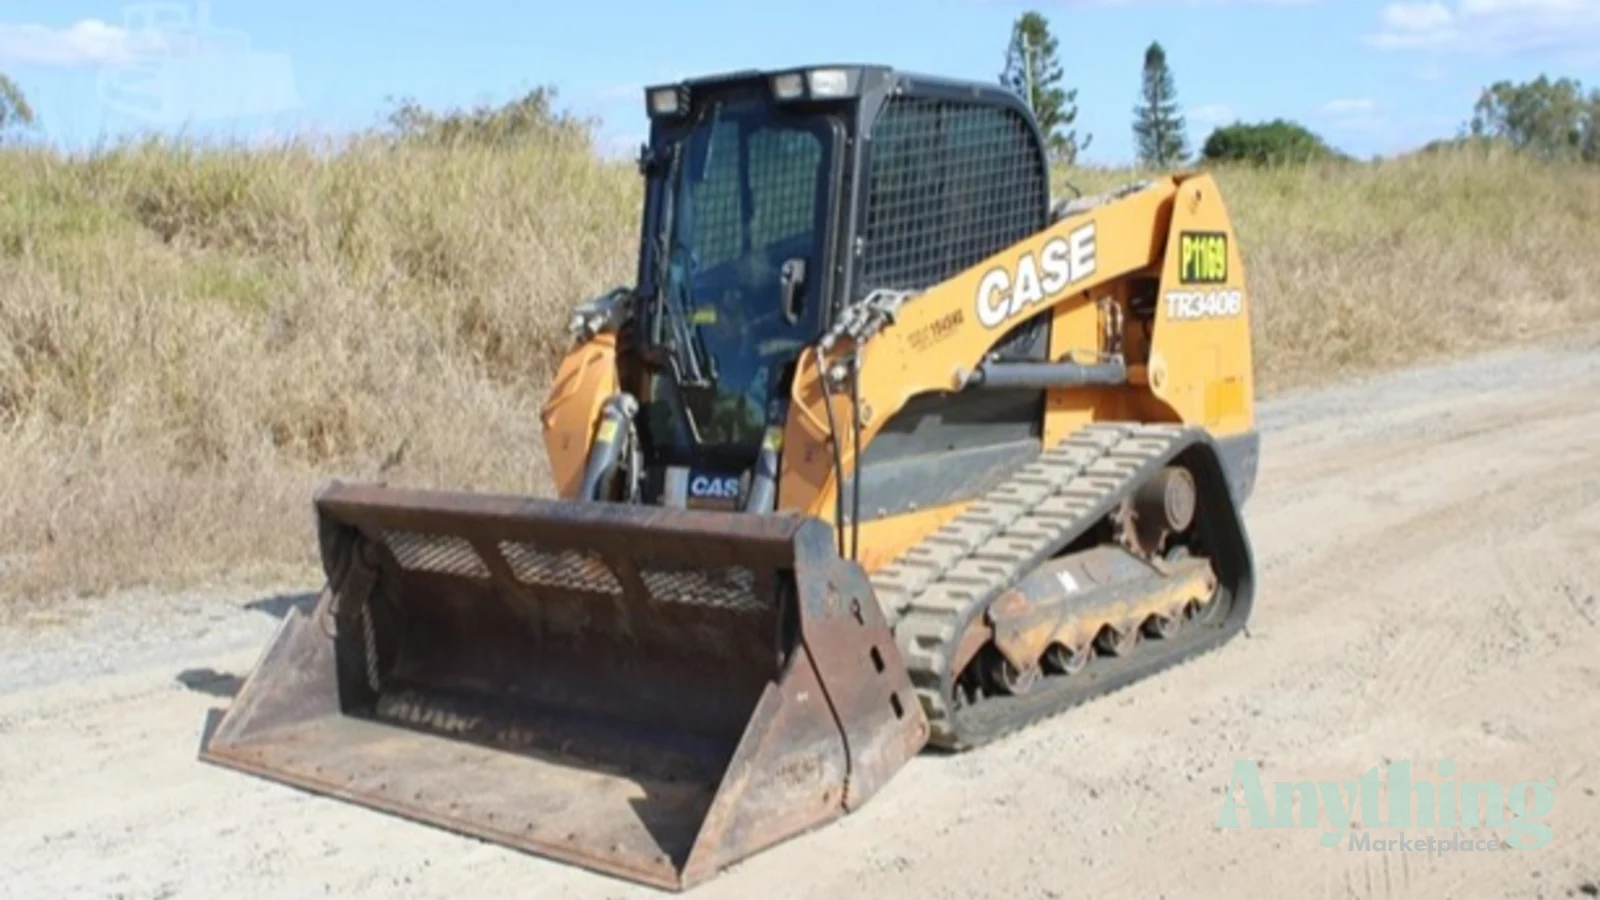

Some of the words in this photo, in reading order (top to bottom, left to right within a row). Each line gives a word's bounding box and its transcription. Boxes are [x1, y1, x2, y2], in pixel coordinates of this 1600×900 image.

[976, 222, 1097, 328] CASE
[1181, 234, 1225, 281] P1169
[691, 475, 739, 497] CAS
